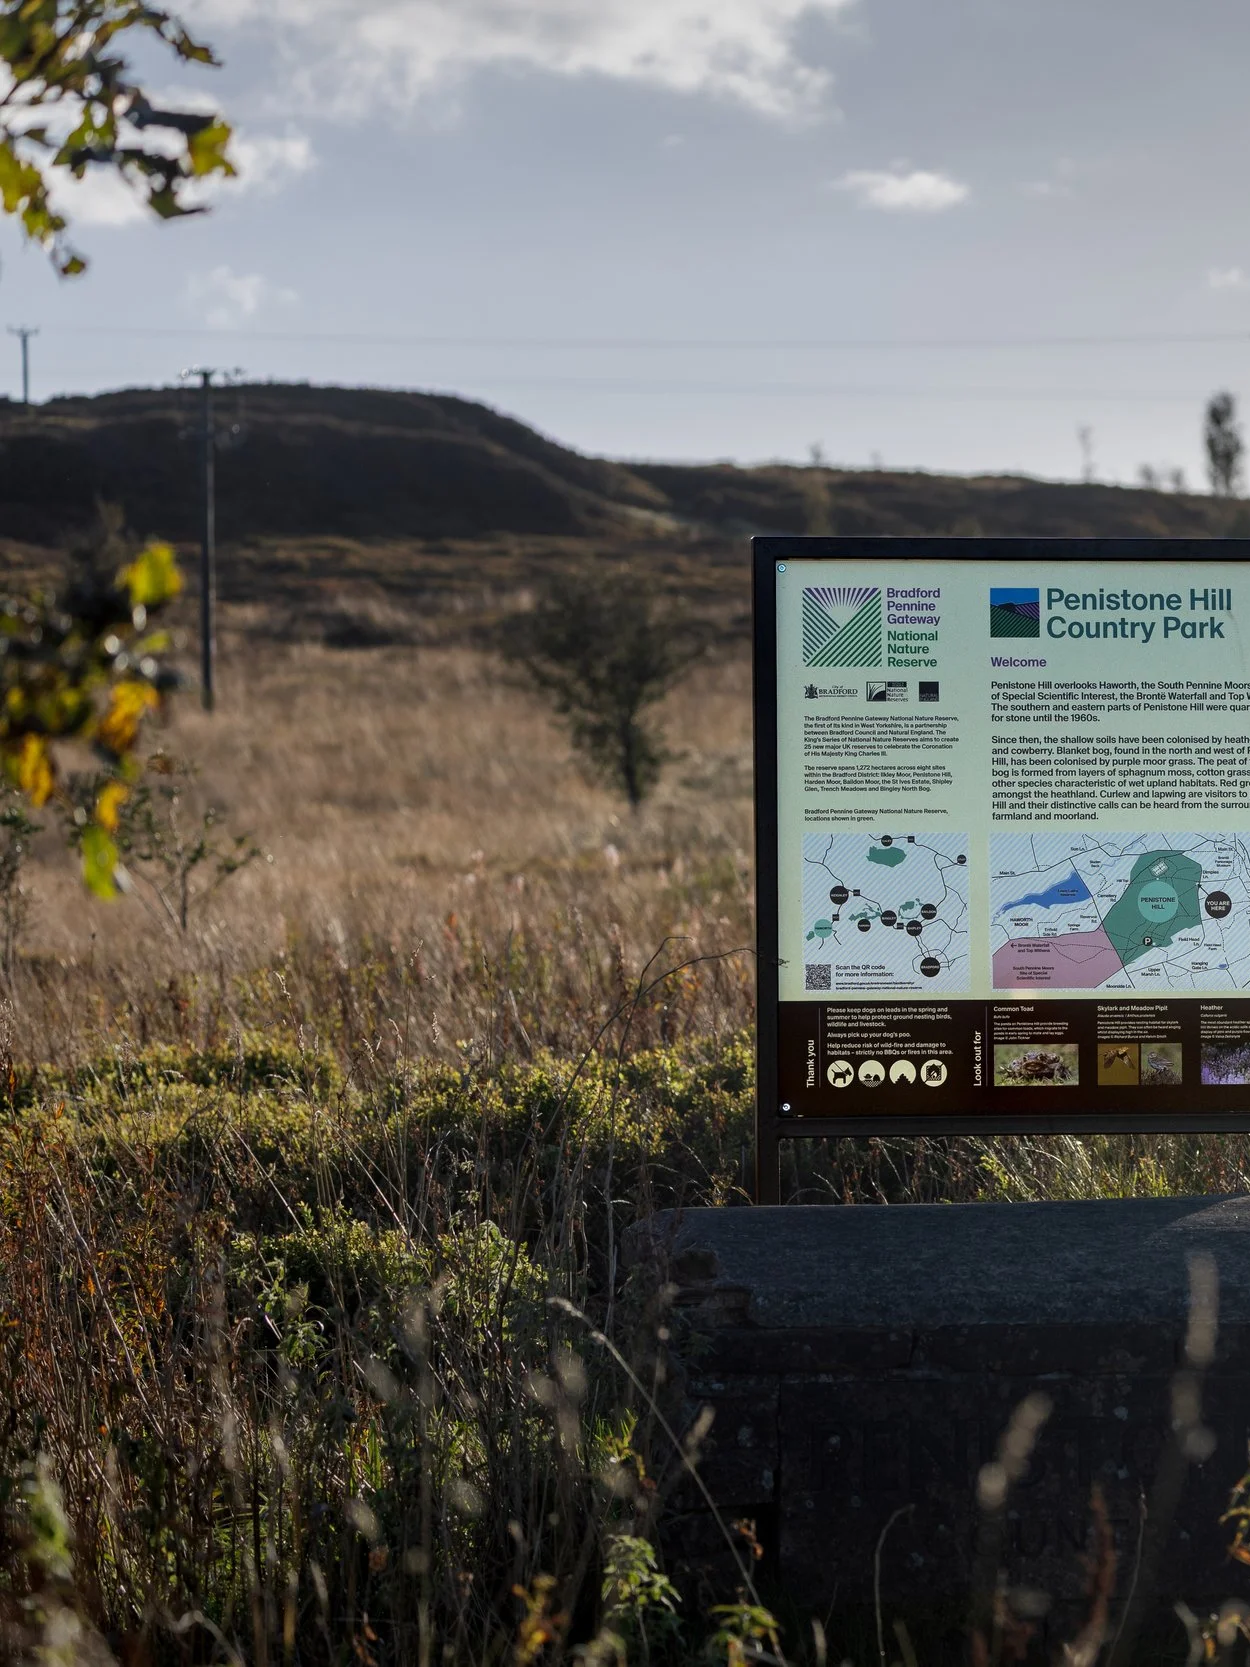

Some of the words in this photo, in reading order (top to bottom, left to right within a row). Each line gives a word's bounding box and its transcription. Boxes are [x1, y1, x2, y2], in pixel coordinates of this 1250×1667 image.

[887, 588, 940, 598] Bradford
[1047, 588, 1182, 611] Penistone
[1190, 588, 1231, 611] Hill
[887, 601, 936, 611] Pennine
[887, 614, 941, 626] Gateway
[1047, 616, 1156, 643] Country
[1164, 616, 1225, 639] Park
[888, 631, 938, 641] National
[888, 644, 929, 654] Nature
[888, 657, 937, 667] Reserve
[991, 657, 1047, 667] Welcome
[991, 681, 1036, 689] Penistone
[1038, 681, 1052, 689] Hill
[1054, 681, 1097, 689] overlooks
[1099, 681, 1139, 690] Haworth,
[1141, 681, 1156, 689] the
[1158, 681, 1184, 689] South
[1186, 681, 1222, 689] Pennine
[991, 692, 1000, 700] of
[1002, 692, 1035, 702] Special
[1037, 692, 1079, 700] Scientific
[1081, 692, 1118, 701] Interest,
[1120, 692, 1134, 700] the
[1137, 692, 1166, 700] Brontë
[1168, 692, 1207, 700] Waterfall
[1209, 692, 1226, 700] and
[1228, 692, 1245, 702] Top
[991, 703, 1008, 711] The
[1010, 703, 1050, 711] southern
[1052, 703, 1069, 711] and
[1071, 703, 1105, 711] eastern
[1107, 703, 1131, 712] parts
[1132, 703, 1142, 711] of
[1144, 703, 1188, 711] Penistone
[1190, 703, 1204, 711] Hill
[991, 714, 1004, 722] for
[1006, 714, 1031, 722] stone
[1033, 714, 1052, 722] until
[1054, 714, 1069, 722] the
[1071, 714, 1100, 722] 1960s.
[992, 736, 1017, 744] Since
[1019, 736, 1041, 745] then,
[1043, 736, 1058, 744] the
[1060, 736, 1094, 744] shallow
[1096, 736, 1116, 744] soils
[1118, 736, 1140, 744] have
[1142, 736, 1164, 744] been
[1166, 736, 1209, 744] colonised
[1212, 736, 1222, 745] by
[992, 812, 1032, 820] farmland
[1034, 812, 1051, 820] and
[1054, 812, 1099, 820] moorland.
[974, 1031, 982, 1044] for
[808, 1039, 816, 1058] you
[974, 1065, 982, 1086] Look
